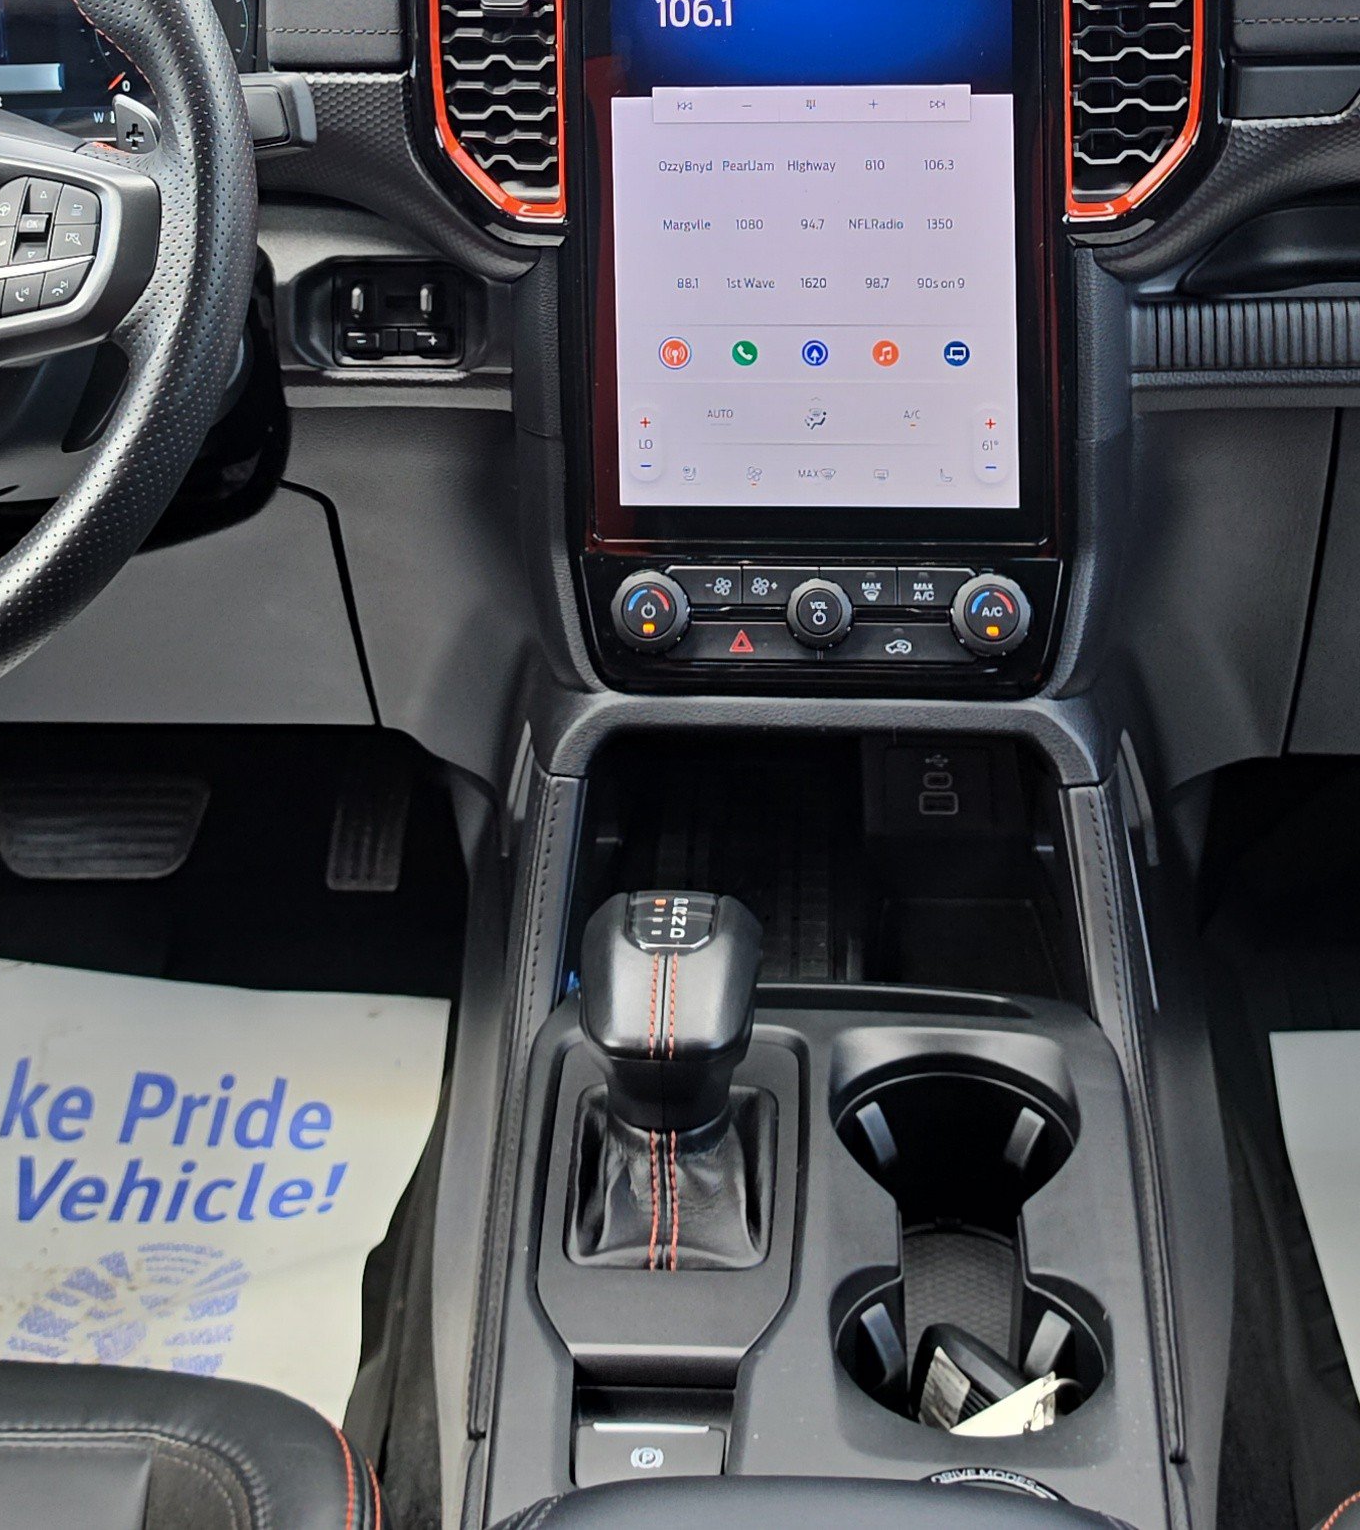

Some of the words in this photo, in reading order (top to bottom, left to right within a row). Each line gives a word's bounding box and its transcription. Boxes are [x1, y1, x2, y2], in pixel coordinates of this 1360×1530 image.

[658, 160, 713, 173] OzzyBnyd
[787, 160, 836, 173] Highway
[865, 159, 885, 170] 810
[923, 159, 955, 170] 106.3
[25, 219, 39, 229] OK
[735, 219, 764, 230] 1080
[800, 218, 825, 230] 94.7
[926, 218, 953, 230] 1350
[677, 277, 700, 290] 88.1
[725, 277, 742, 289] 1st
[743, 278, 775, 290] Wave
[800, 277, 827, 289] 1620
[864, 277, 890, 289] 98.7
[917, 277, 939, 289] 90s
[941, 280, 955, 289] on
[957, 277, 965, 289] 9
[707, 408, 734, 420] AUTO
[903, 408, 921, 421] A/C
[638, 439, 653, 450] LO
[797, 468, 819, 480] MAX
[861, 582, 883, 591] MAX
[913, 582, 934, 591] MAX
[913, 590, 935, 602] A/C
[809, 601, 828, 610] VOL
[981, 606, 1003, 618] A/C
[671, 915, 687, 927] N
[669, 927, 686, 939] D
[116, 1070, 336, 1151] Pride
[15, 1155, 349, 1222] Vehicle!
